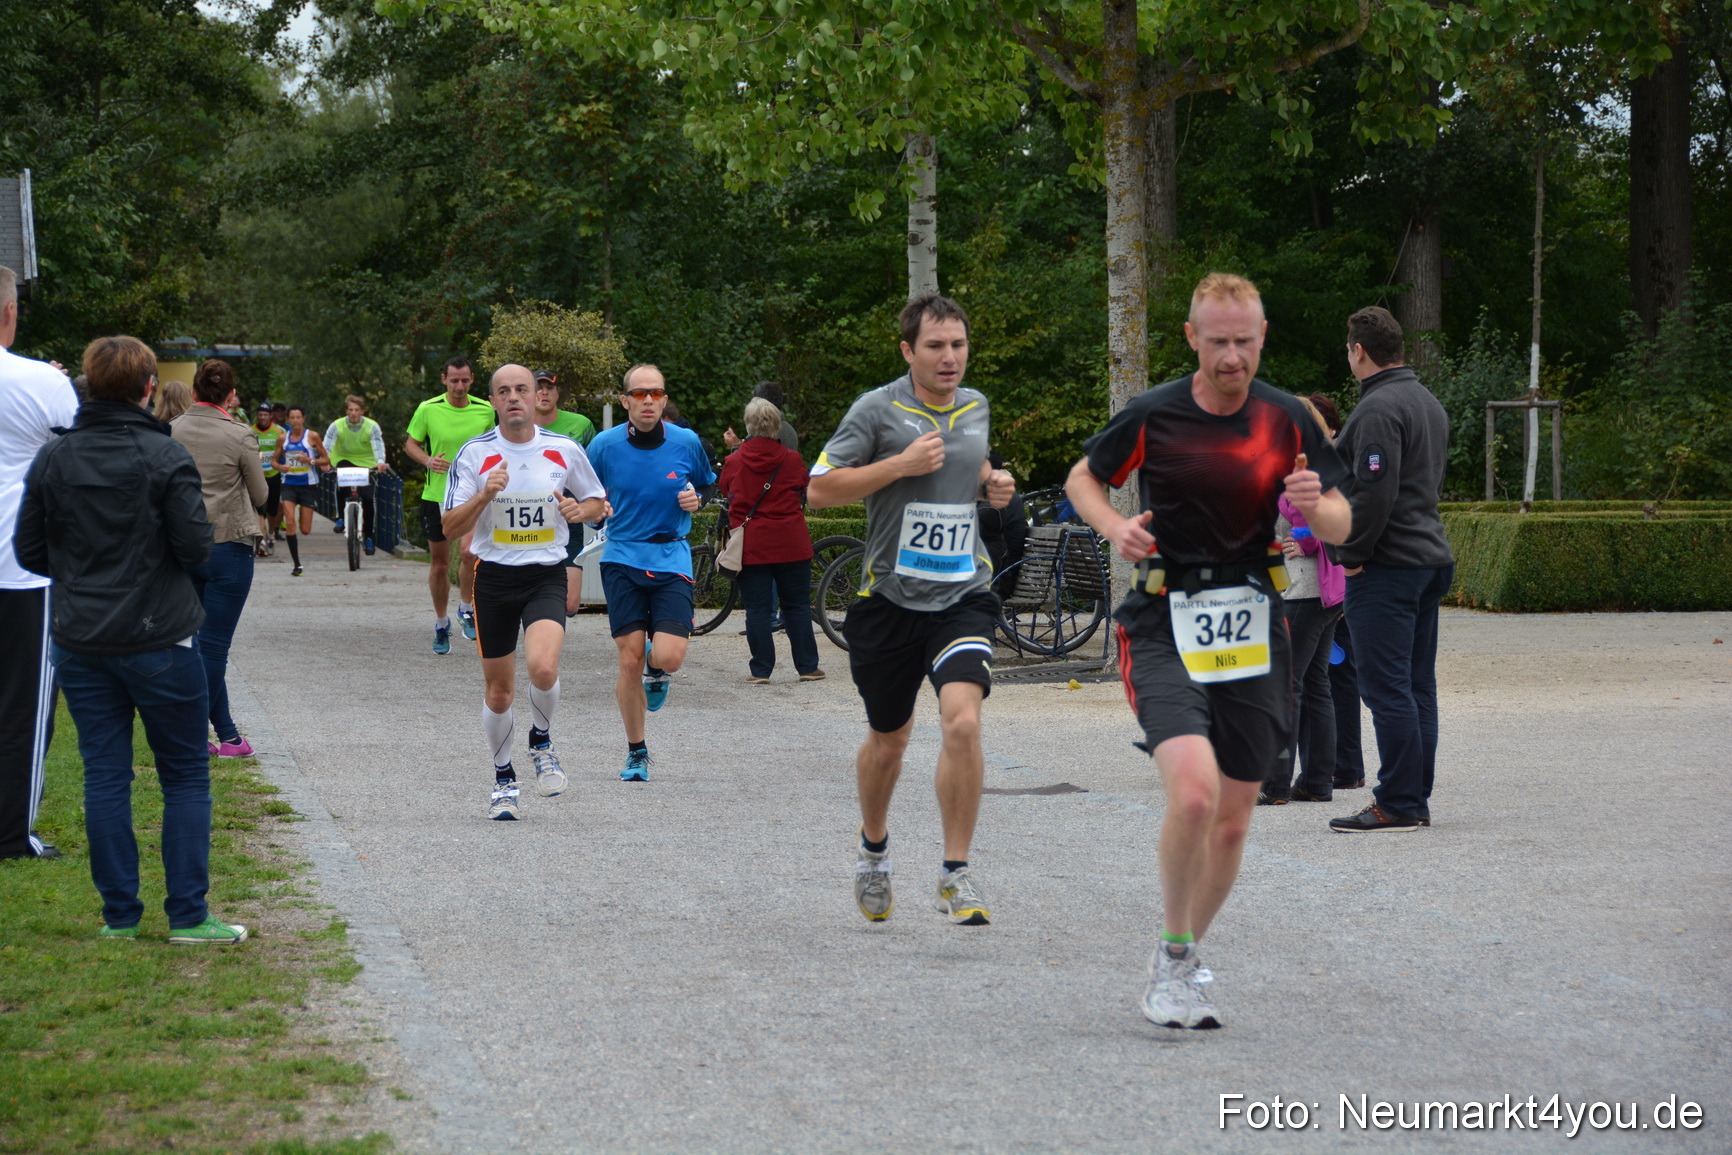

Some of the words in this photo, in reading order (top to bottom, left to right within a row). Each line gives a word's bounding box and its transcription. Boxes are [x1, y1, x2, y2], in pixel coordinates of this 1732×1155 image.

[505, 506, 545, 528] 154
[906, 508, 935, 519] PARTL
[936, 511, 968, 520] Neumarkt
[511, 533, 538, 542] Martin
[909, 521, 971, 552] 2617
[913, 555, 961, 571] Johannes
[1173, 600, 1207, 610] PARTL
[1209, 596, 1253, 608] Neumarkt
[1194, 609, 1252, 646] 342
[1215, 654, 1238, 668] Nils
